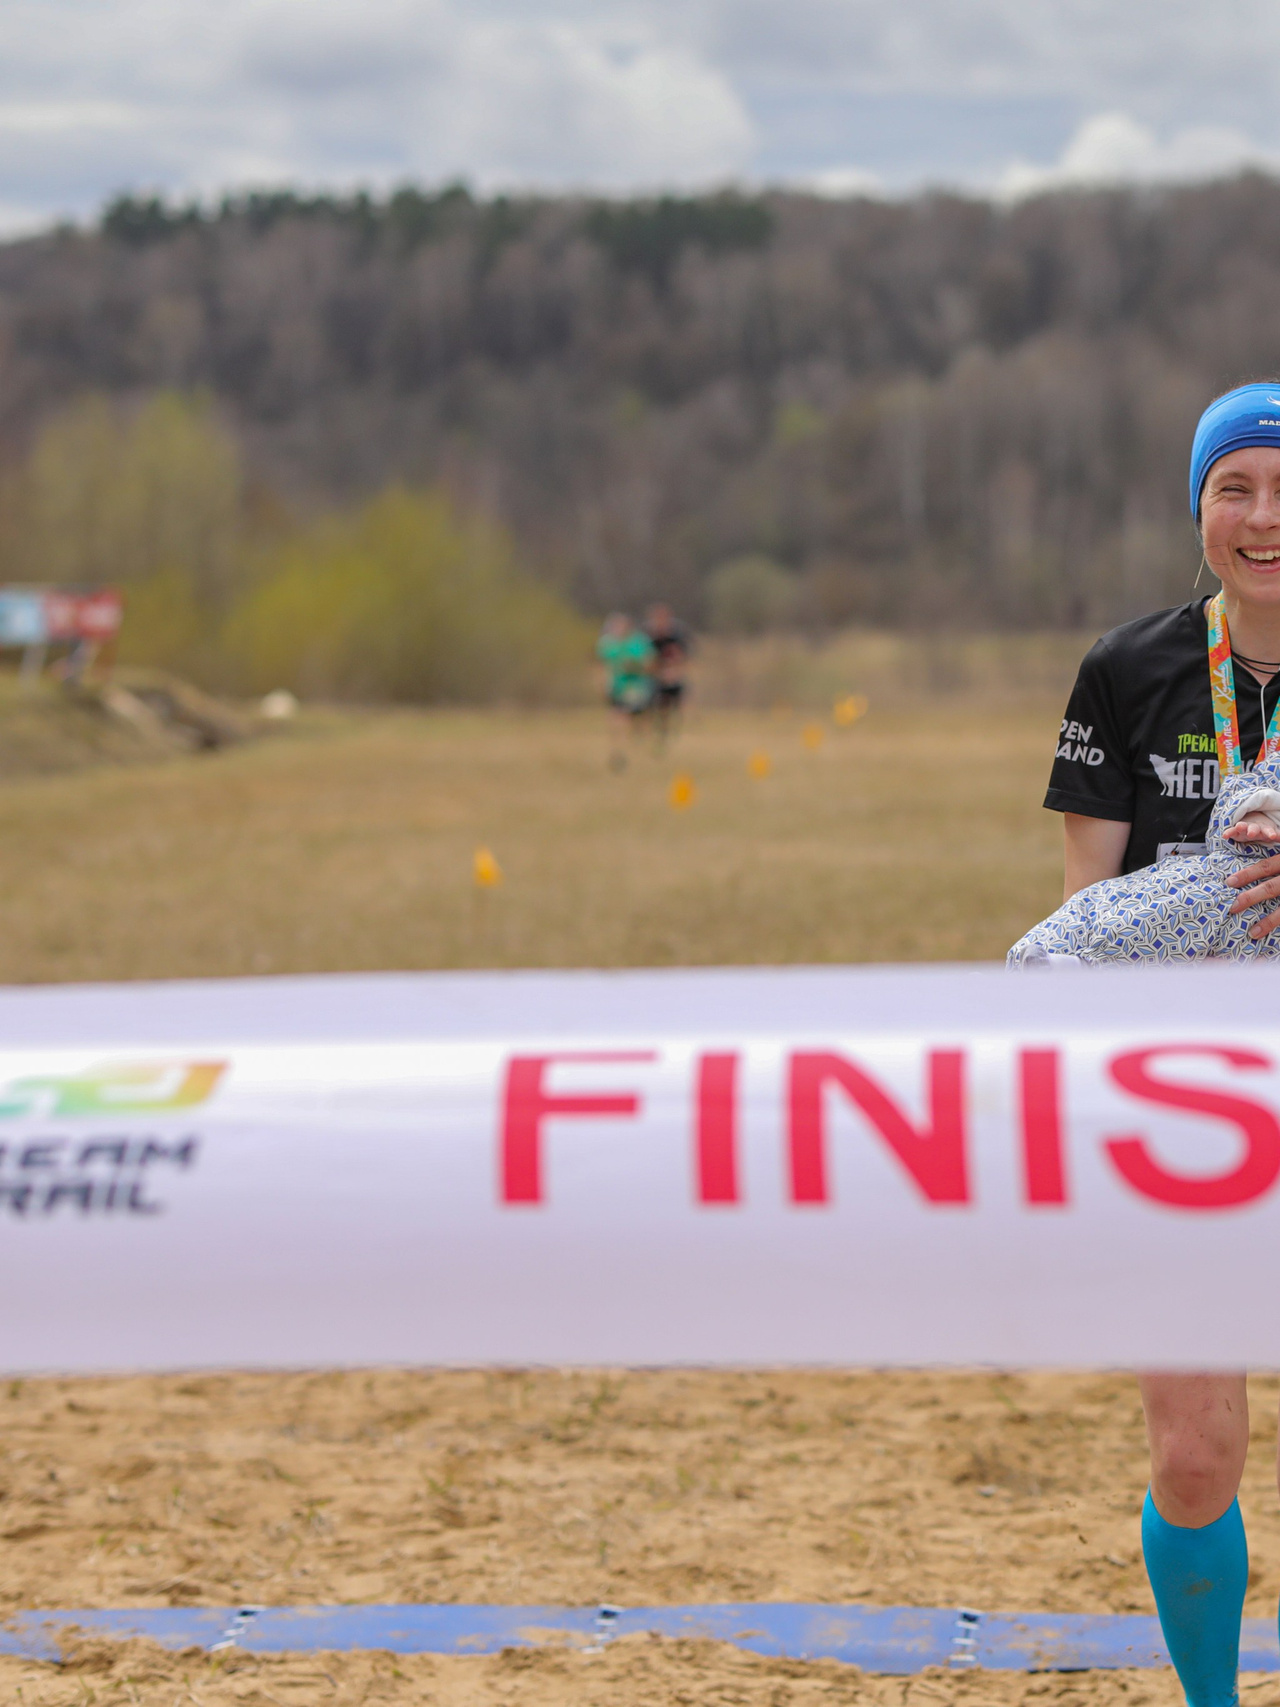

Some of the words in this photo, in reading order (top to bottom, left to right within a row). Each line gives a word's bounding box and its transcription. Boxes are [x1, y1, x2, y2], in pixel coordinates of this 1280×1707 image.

[1223, 719, 1232, 738] ЛЕС
[1055, 739, 1105, 767] AND
[1223, 739, 1236, 776] ИНСКИЙ
[0, 1135, 197, 1171] EAM
